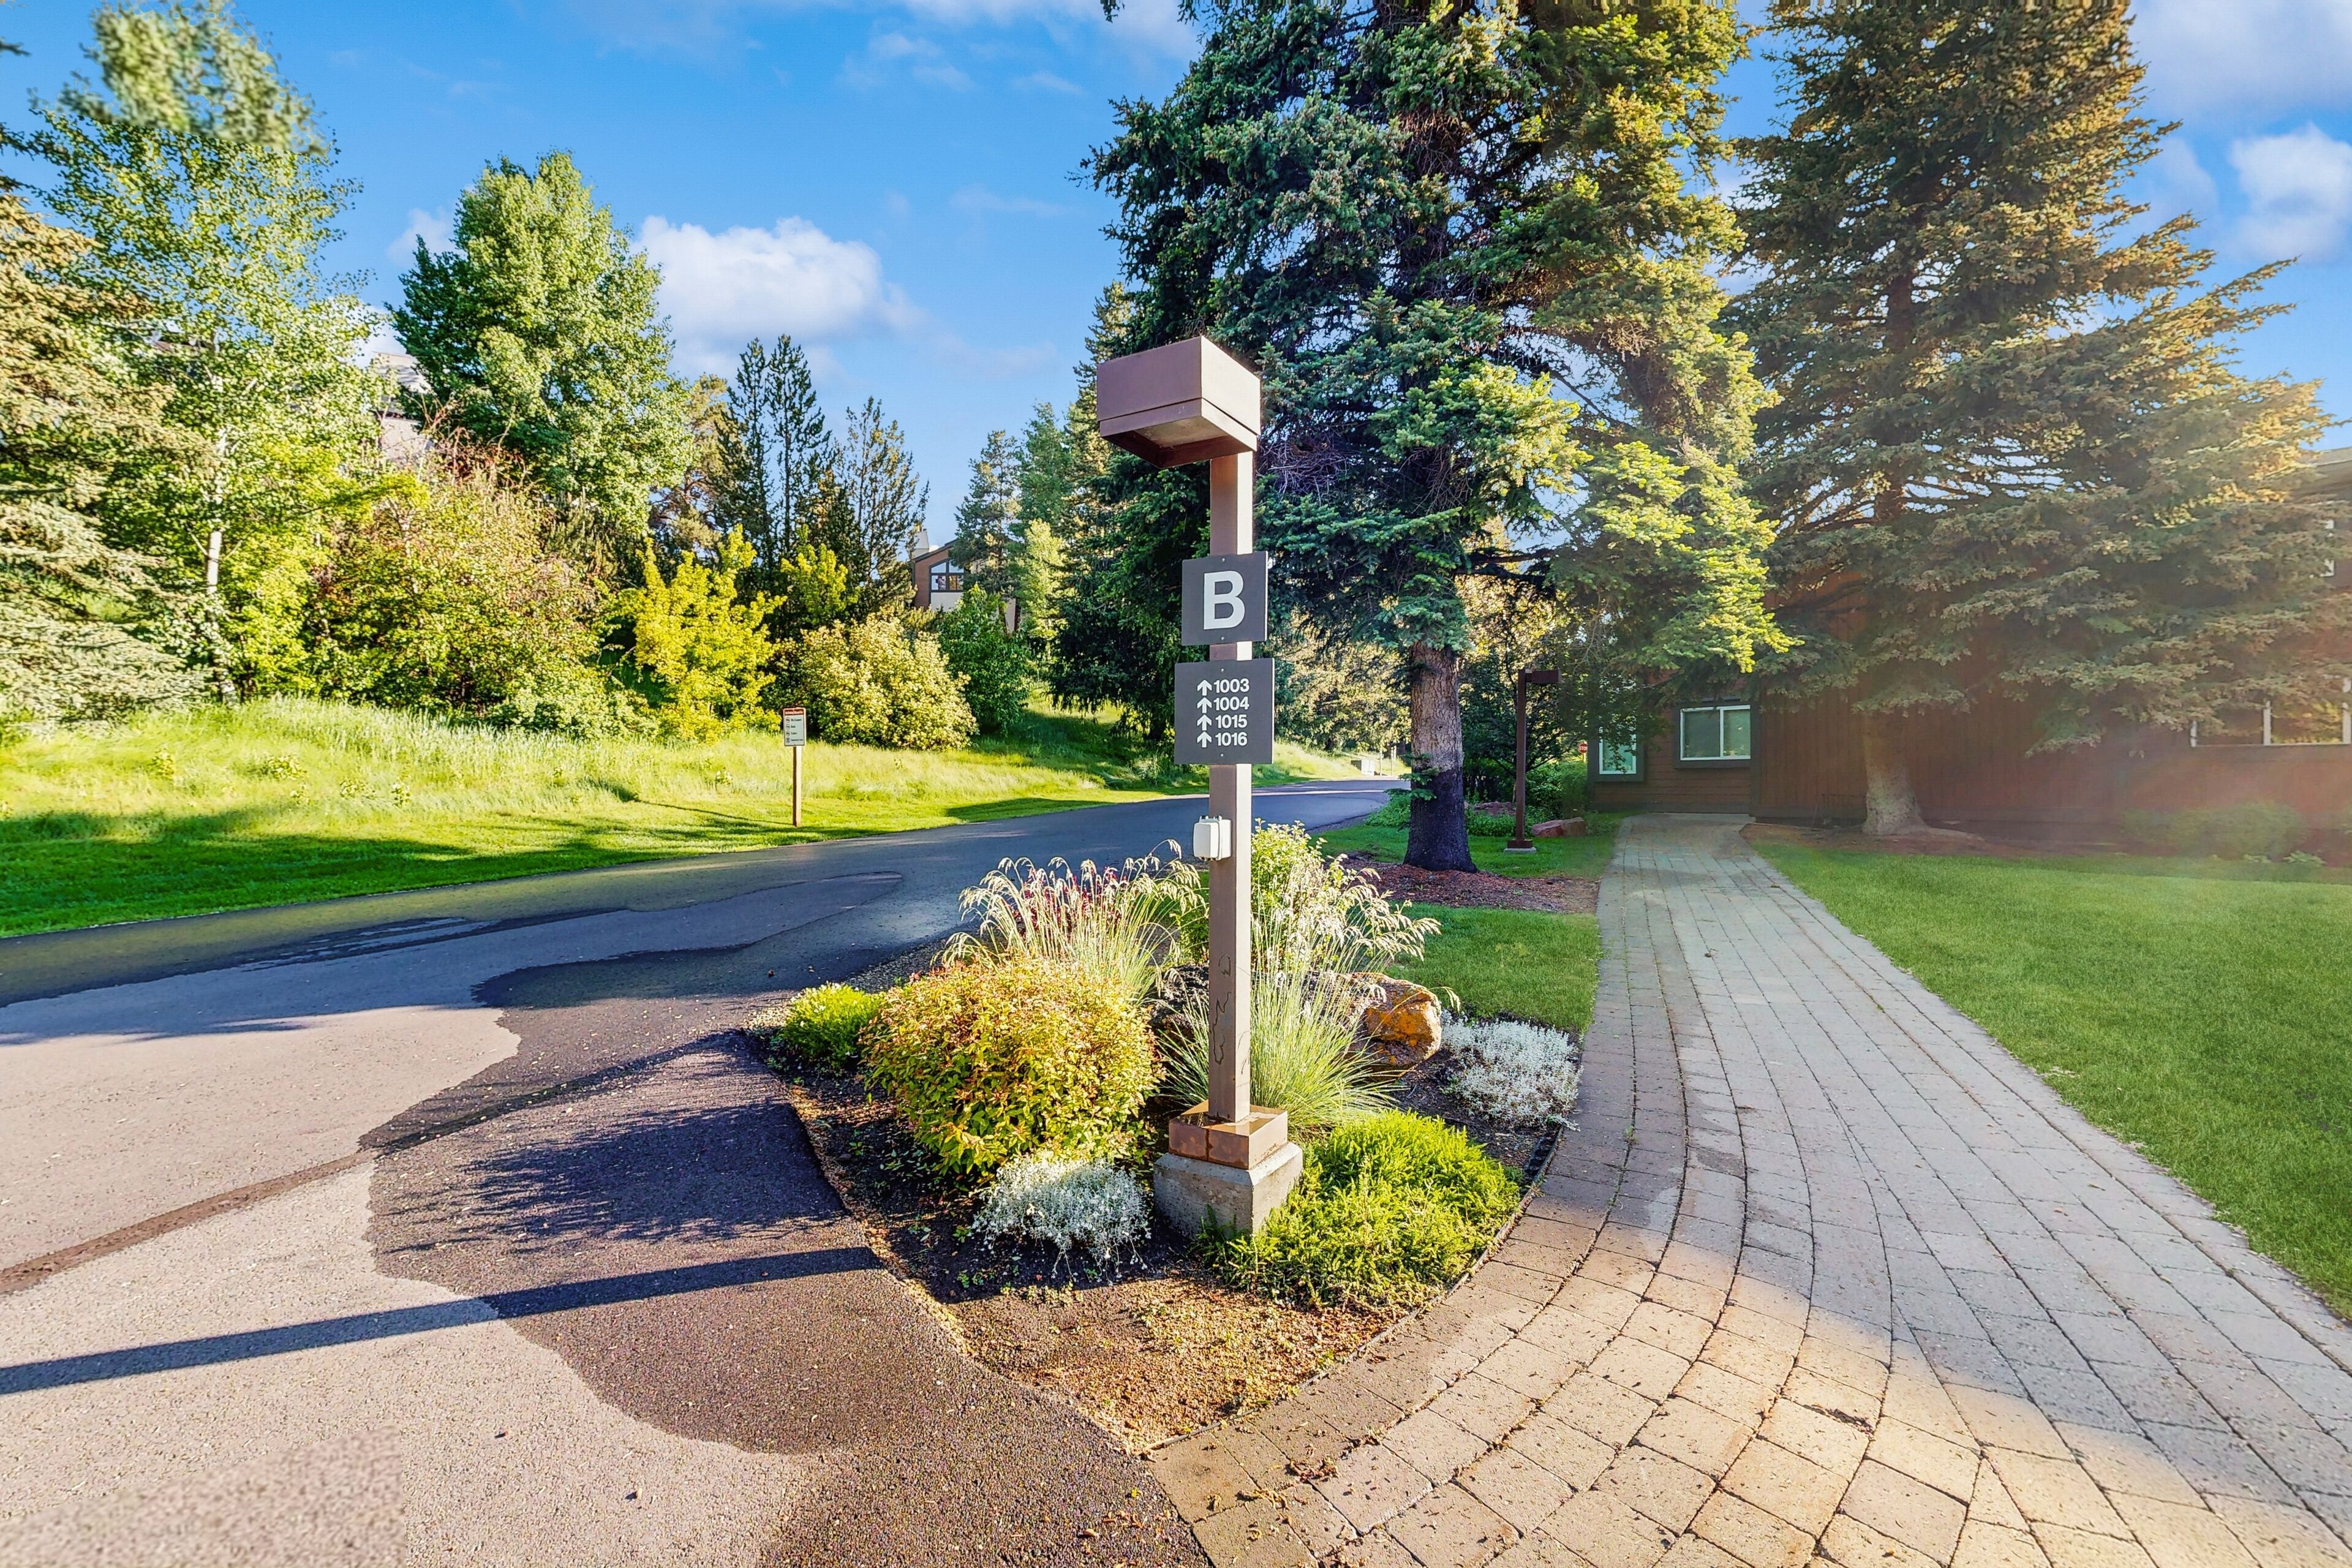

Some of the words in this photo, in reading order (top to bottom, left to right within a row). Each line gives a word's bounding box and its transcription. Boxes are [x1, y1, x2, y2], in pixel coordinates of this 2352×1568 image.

[1204, 570, 1245, 630] B
[1213, 678, 1250, 693] 1003
[1213, 696, 1250, 711] 1004
[1215, 714, 1248, 729] 1015
[1215, 731, 1248, 747] 1016
